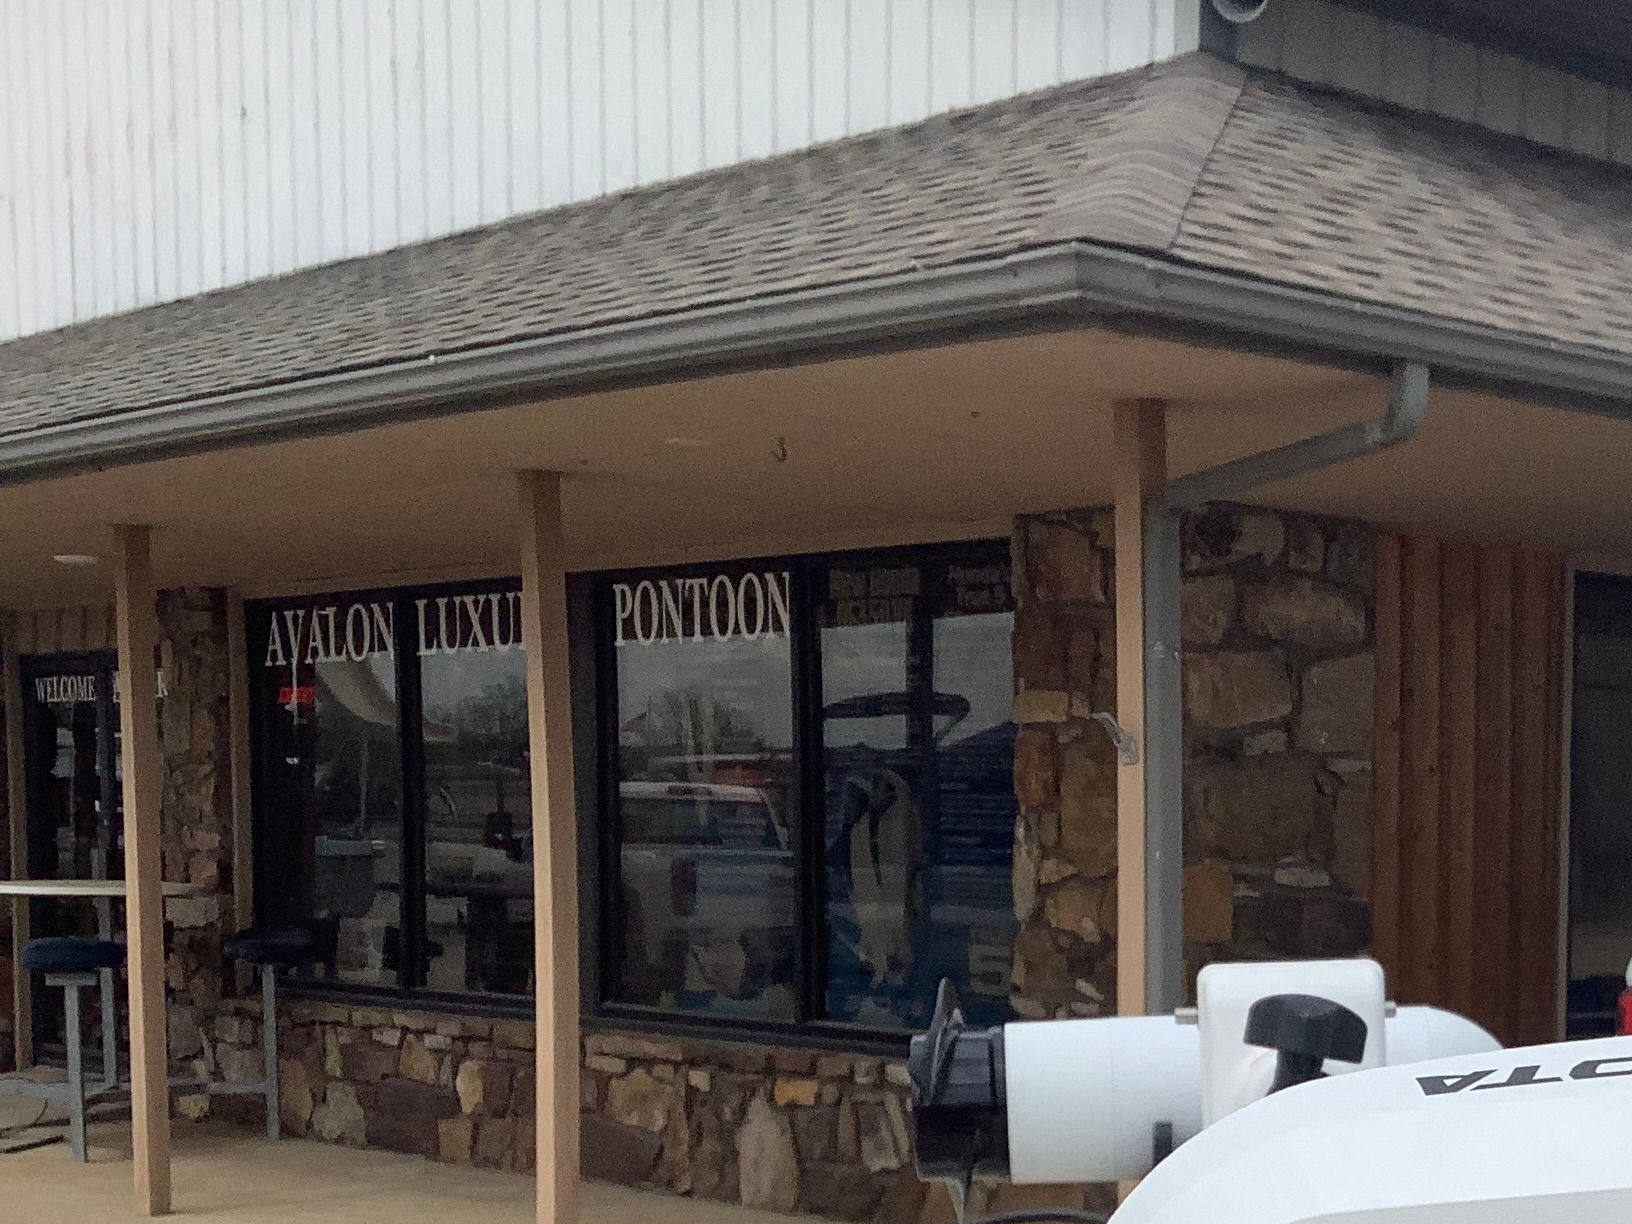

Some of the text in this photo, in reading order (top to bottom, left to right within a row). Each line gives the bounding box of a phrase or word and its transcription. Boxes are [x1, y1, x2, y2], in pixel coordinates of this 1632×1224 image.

[265, 602, 394, 665] AVALON
[416, 591, 525, 656] LUXU
[613, 572, 789, 646] PONTOON
[35, 674, 96, 702] WELCOME
